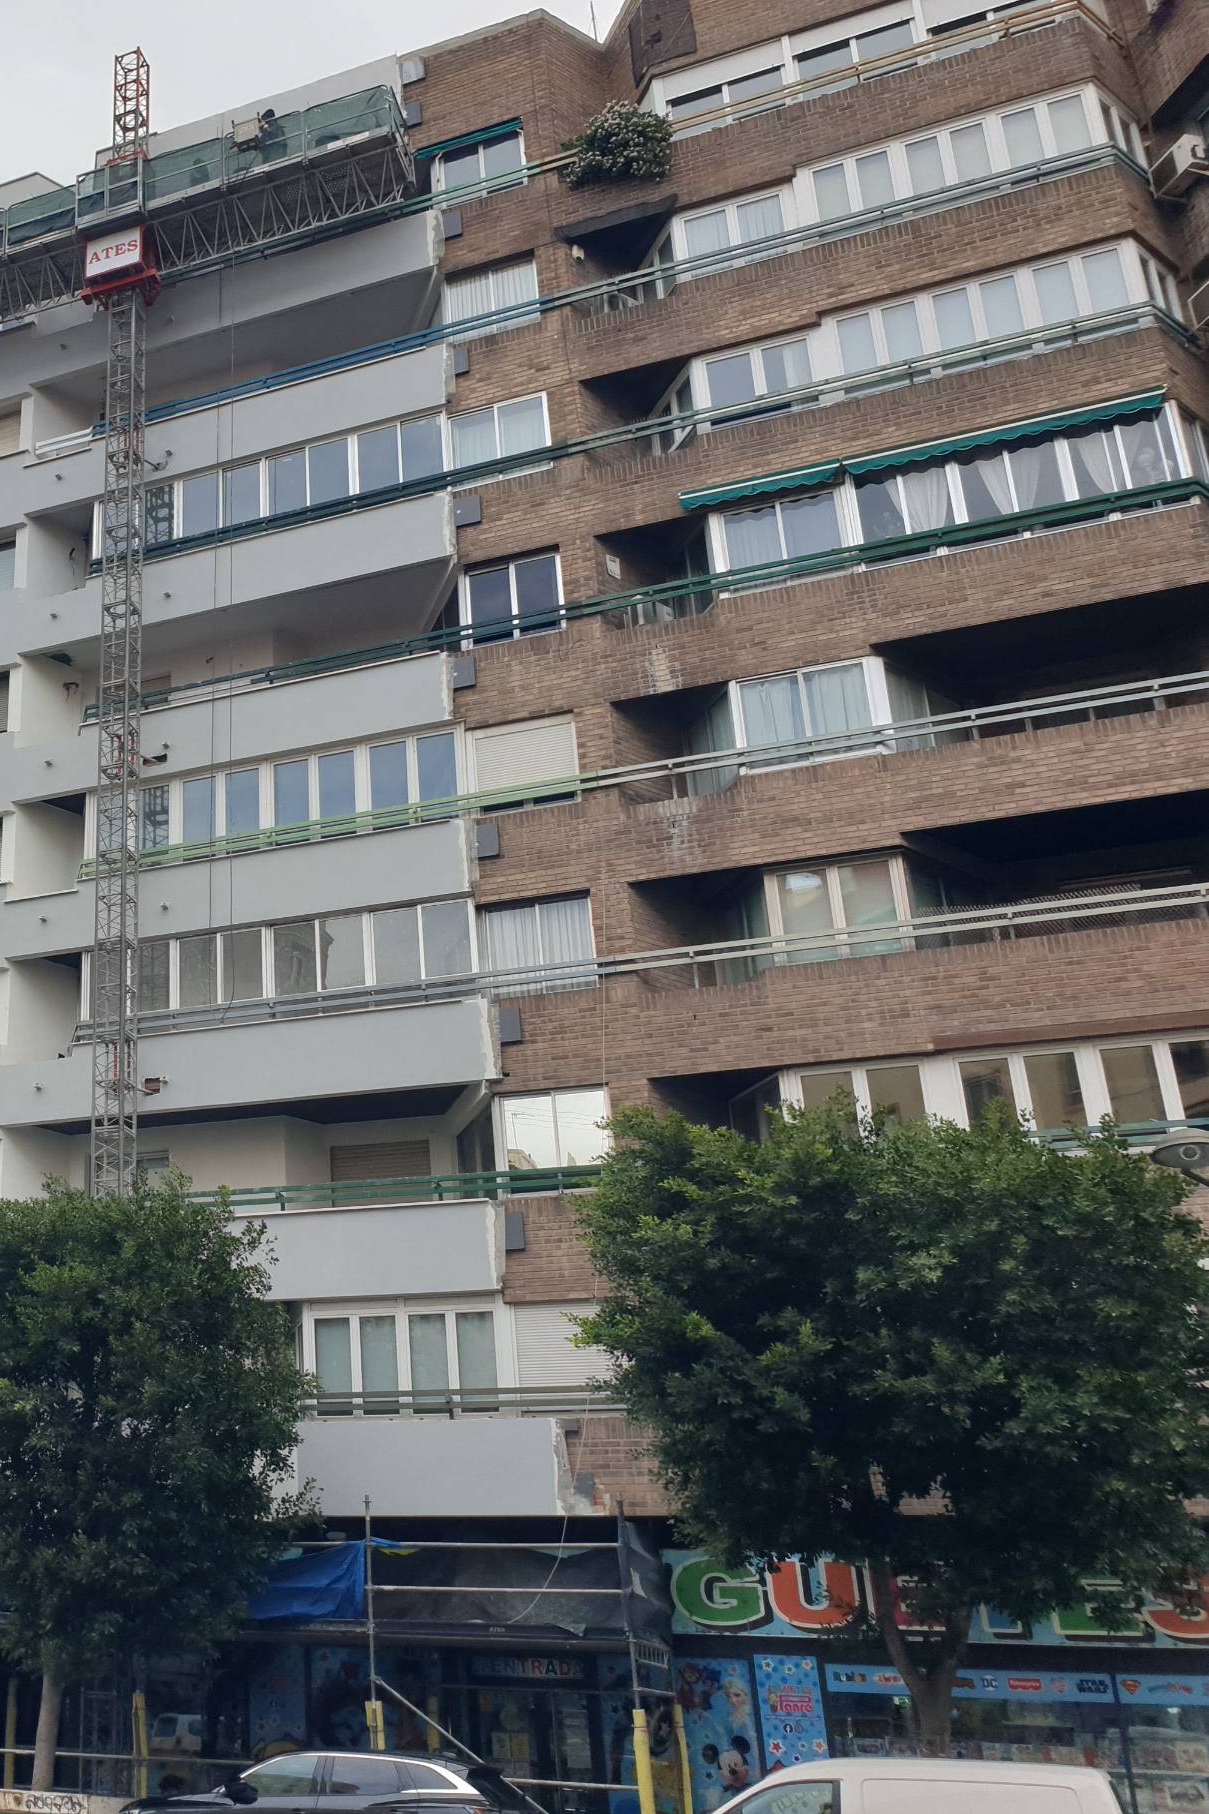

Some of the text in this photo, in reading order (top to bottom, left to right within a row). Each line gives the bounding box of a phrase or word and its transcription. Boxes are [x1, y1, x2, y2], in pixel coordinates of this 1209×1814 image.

[89, 240, 138, 264] ATES
[981, 1677, 998, 1689] DC
[1077, 1685, 1109, 1694] WARS
